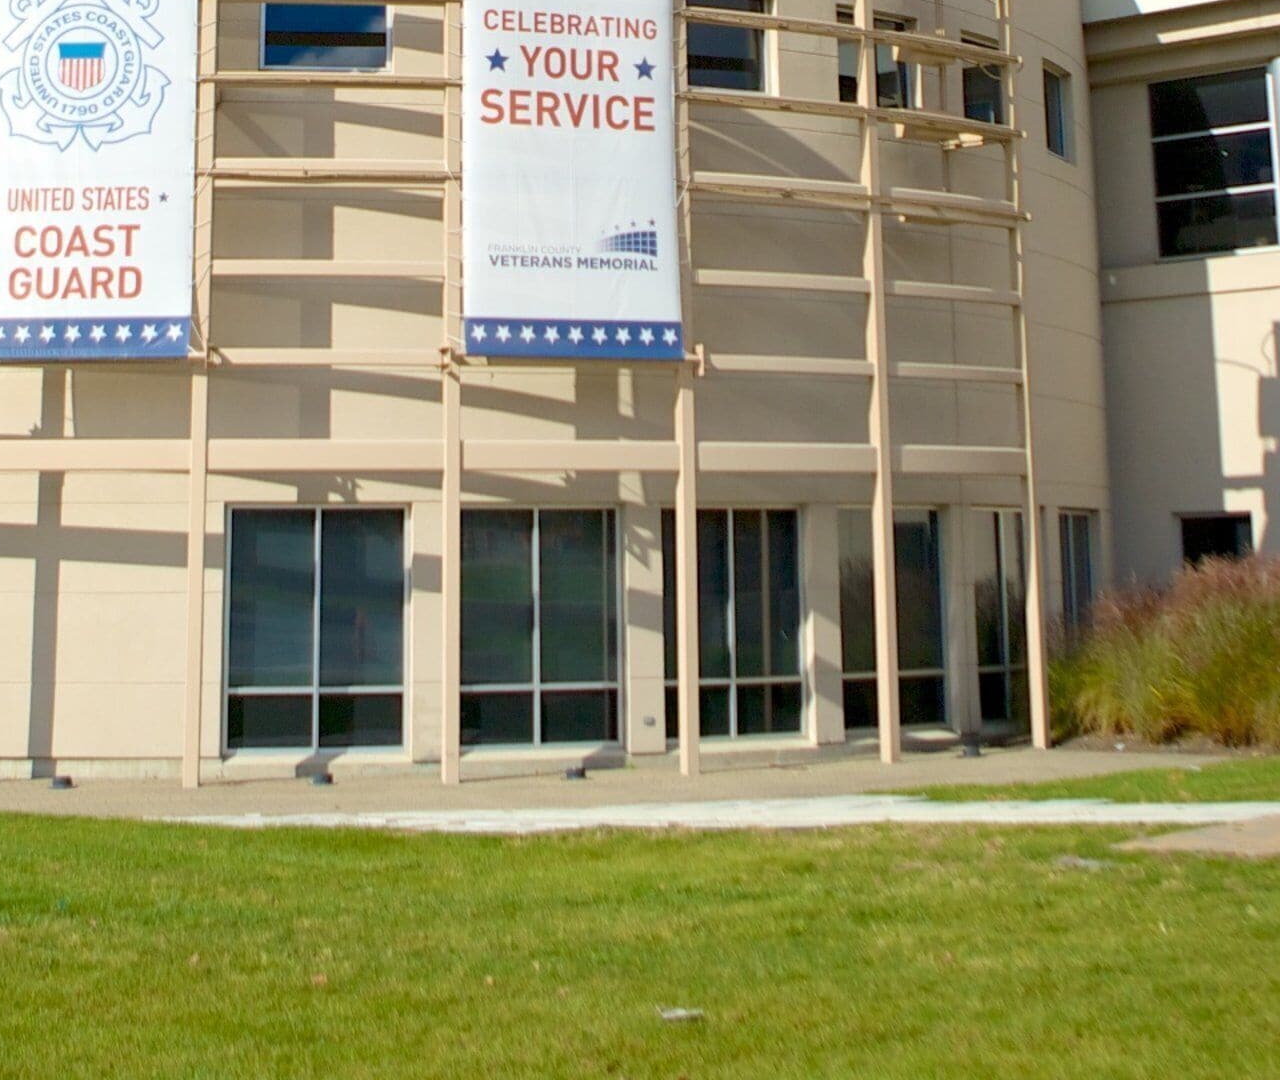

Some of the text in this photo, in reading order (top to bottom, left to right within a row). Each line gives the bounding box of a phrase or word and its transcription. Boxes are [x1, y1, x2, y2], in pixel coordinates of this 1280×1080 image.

[483, 8, 657, 40] CELEBRATING
[30, 10, 135, 109] UNITED STATES COAST GUARD
[520, 44, 619, 83] YOUR
[61, 103, 99, 116] 1790
[480, 88, 655, 132] SERVICE
[7, 186, 150, 212] UNITED STATES
[14, 223, 141, 259] COAST
[489, 254, 658, 271] VETERANS MEMORIAL
[8, 265, 143, 301] GUARD
